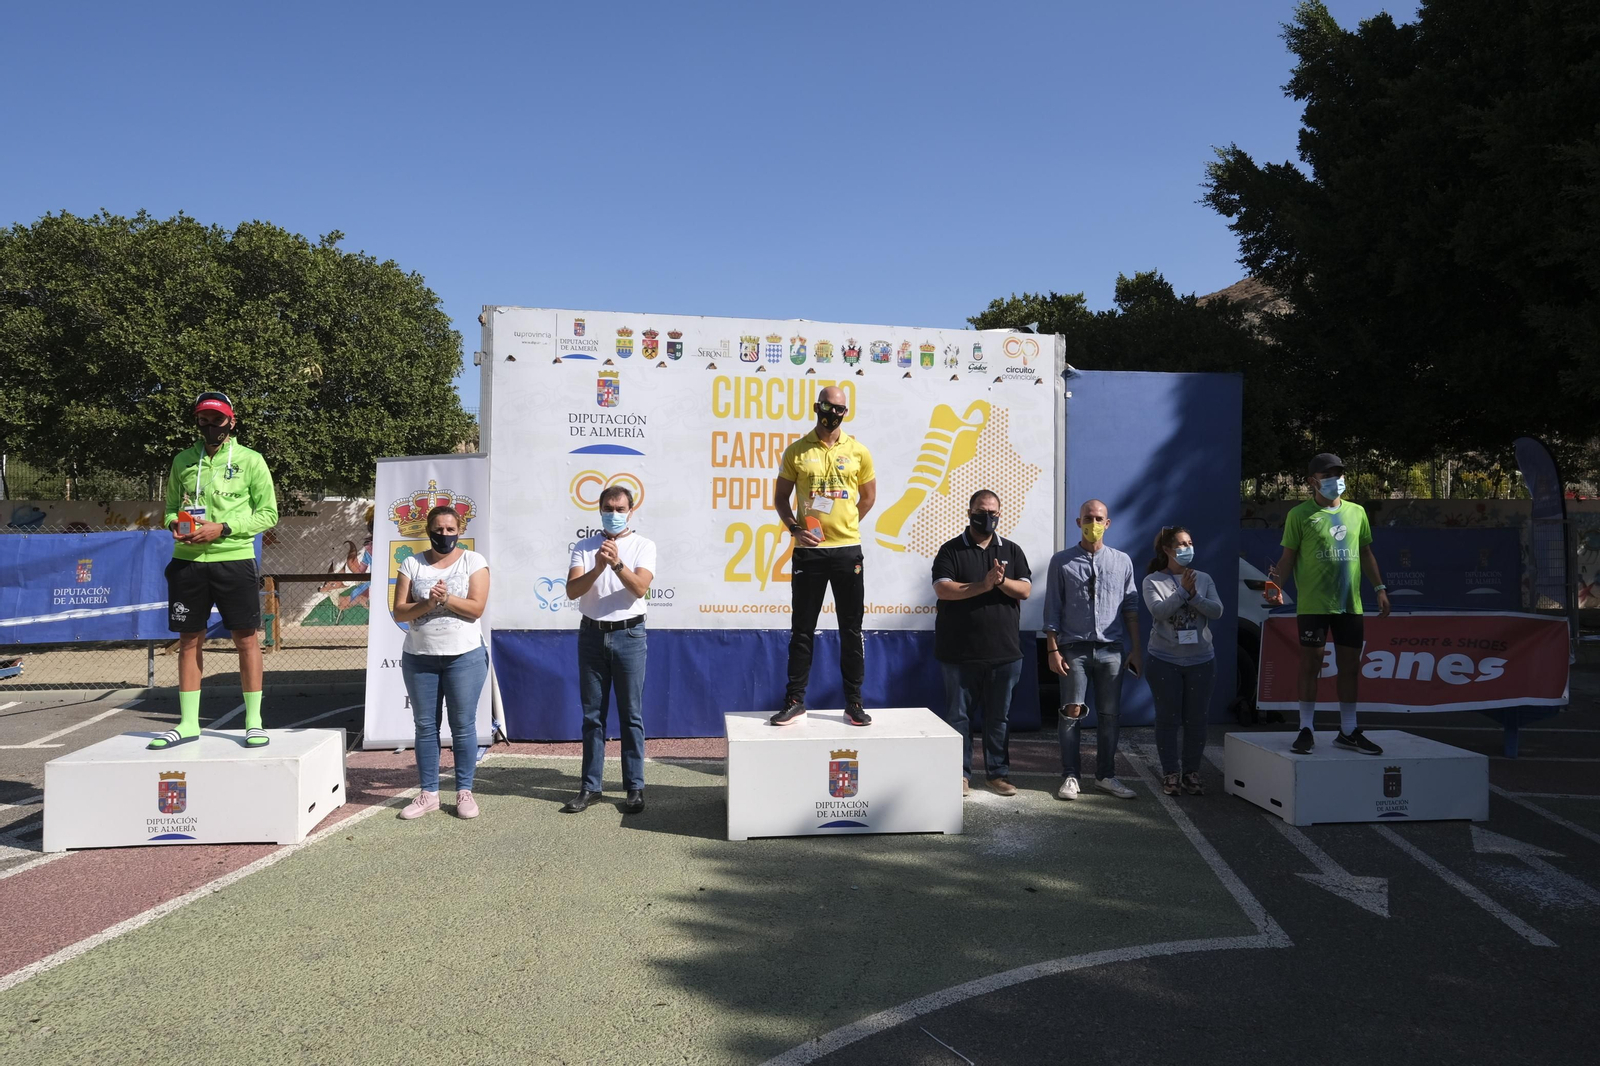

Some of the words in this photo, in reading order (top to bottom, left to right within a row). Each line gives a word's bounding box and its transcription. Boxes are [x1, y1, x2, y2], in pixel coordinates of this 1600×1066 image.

[560, 338, 599, 346] DIPUTACIÓN
[1005, 366, 1035, 374] circuitos
[712, 375, 856, 422] CIRCUIO
[568, 412, 647, 425] DIPUTACIÓN
[570, 426, 586, 437] DE
[589, 425, 645, 438] ALMERÍA
[723, 521, 793, 591] 202
[53, 586, 111, 596] DIPUTACIÓN
[53, 597, 67, 605] DE
[68, 595, 108, 605] ALMERÍA
[699, 602, 939, 614] www.carreraulalmeria.com
[1390, 637, 1439, 647] SPORT
[1441, 637, 1452, 647] &
[1456, 637, 1508, 652] SHOES
[1317, 641, 1508, 685] Banes
[815, 799, 869, 809] DIPUTACIÓN
[816, 810, 828, 818] DE
[830, 809, 867, 818] ALMERÍA
[146, 816, 198, 825] DIPUTACIÓN
[160, 824, 197, 833] ALMERÍA
